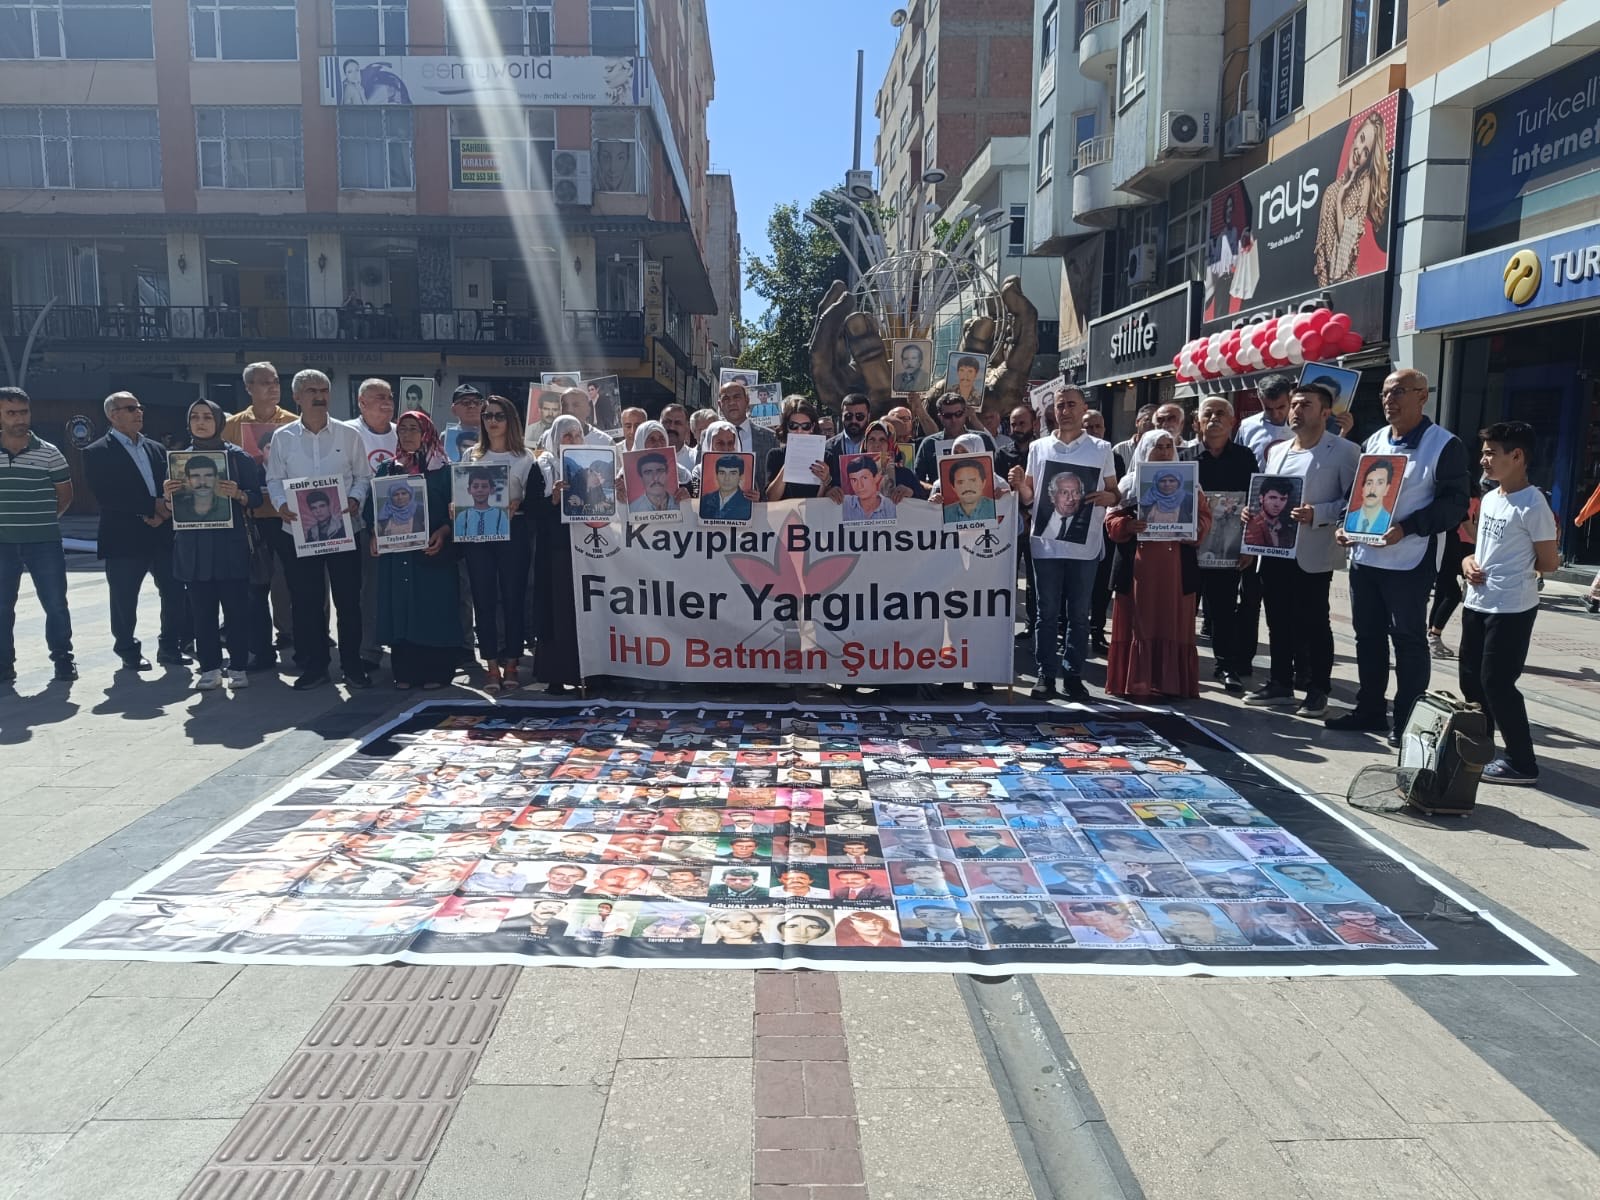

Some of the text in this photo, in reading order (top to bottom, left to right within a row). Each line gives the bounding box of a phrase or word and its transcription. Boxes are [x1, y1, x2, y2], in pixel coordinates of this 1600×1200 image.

[1279, 65, 1290, 111] DENT
[1258, 167, 1320, 230] rays
[1110, 312, 1158, 360] stilife
[312, 478, 339, 487] ÇELİK
[625, 521, 960, 560] Kayıplar Bulunsun
[581, 574, 1011, 632] Failler Yargılansın
[609, 626, 968, 677] İHD Batman Şubesi
